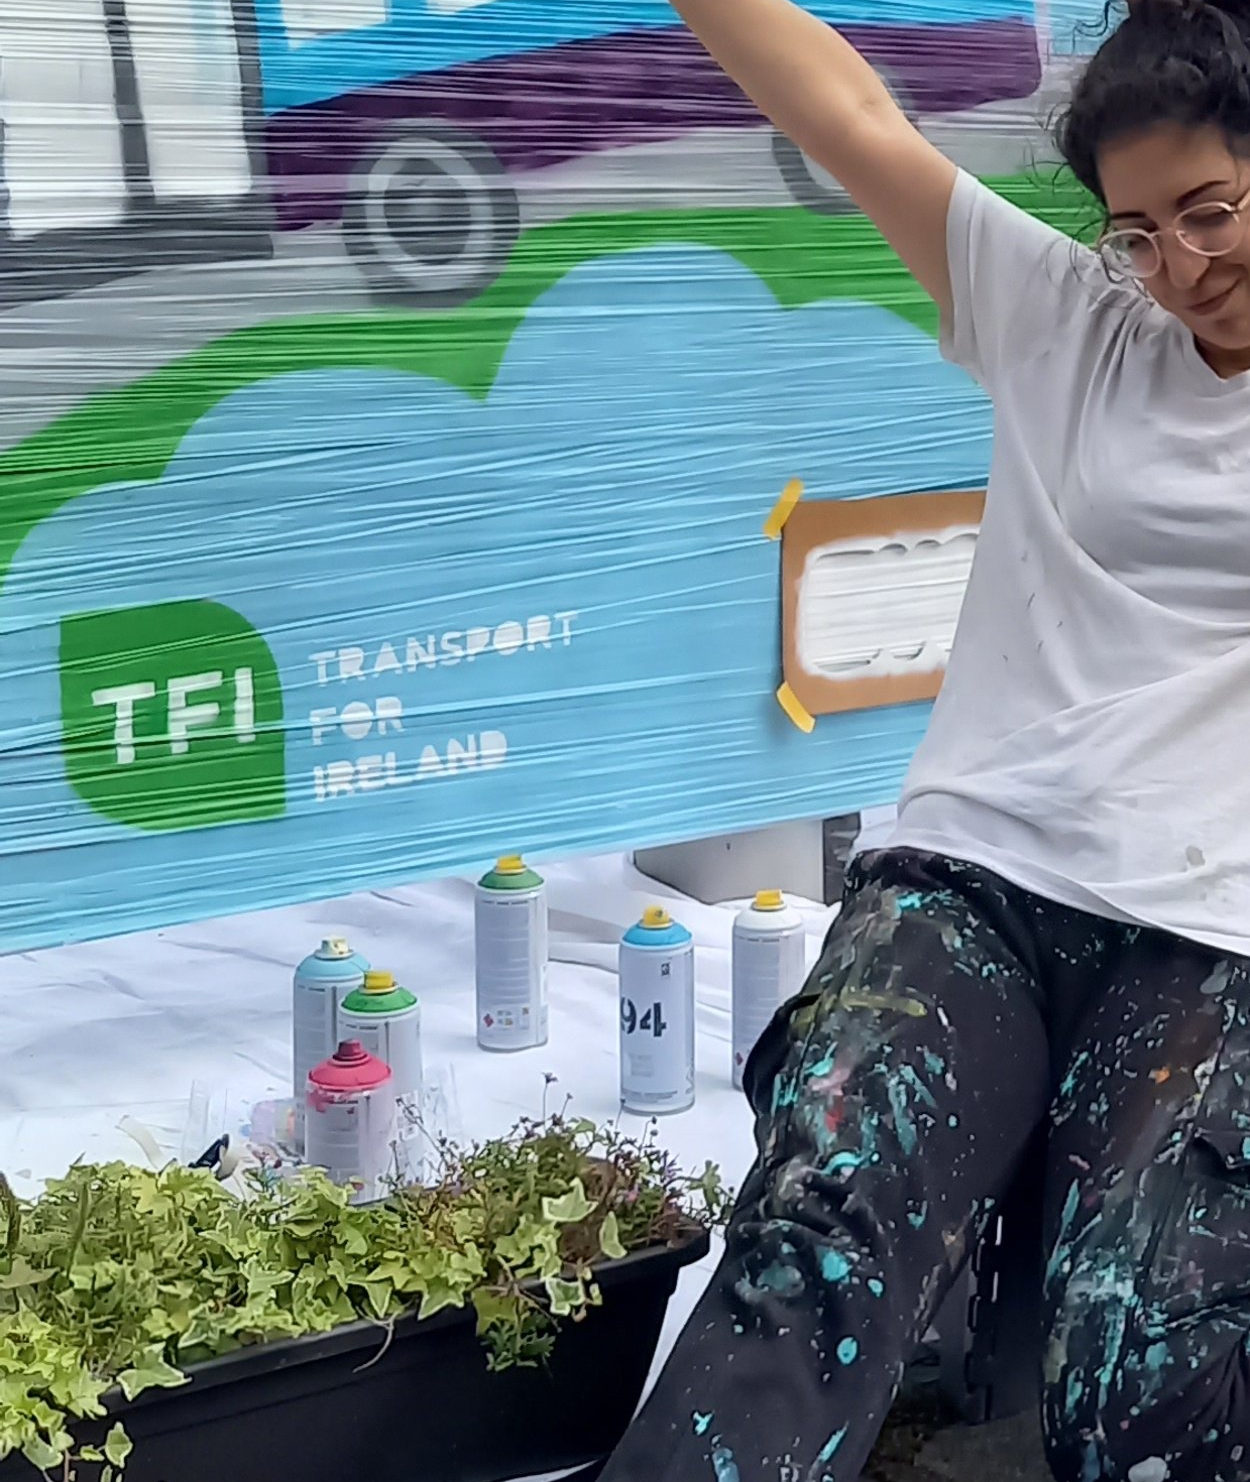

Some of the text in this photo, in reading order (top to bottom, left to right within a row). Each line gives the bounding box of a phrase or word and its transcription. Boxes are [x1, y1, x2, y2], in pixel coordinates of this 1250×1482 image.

[308, 611, 579, 687] TRANSPORT
[91, 666, 257, 765] TFI
[309, 696, 406, 747] FOR
[312, 730, 509, 802] IRELAND
[620, 996, 667, 1038] 94
